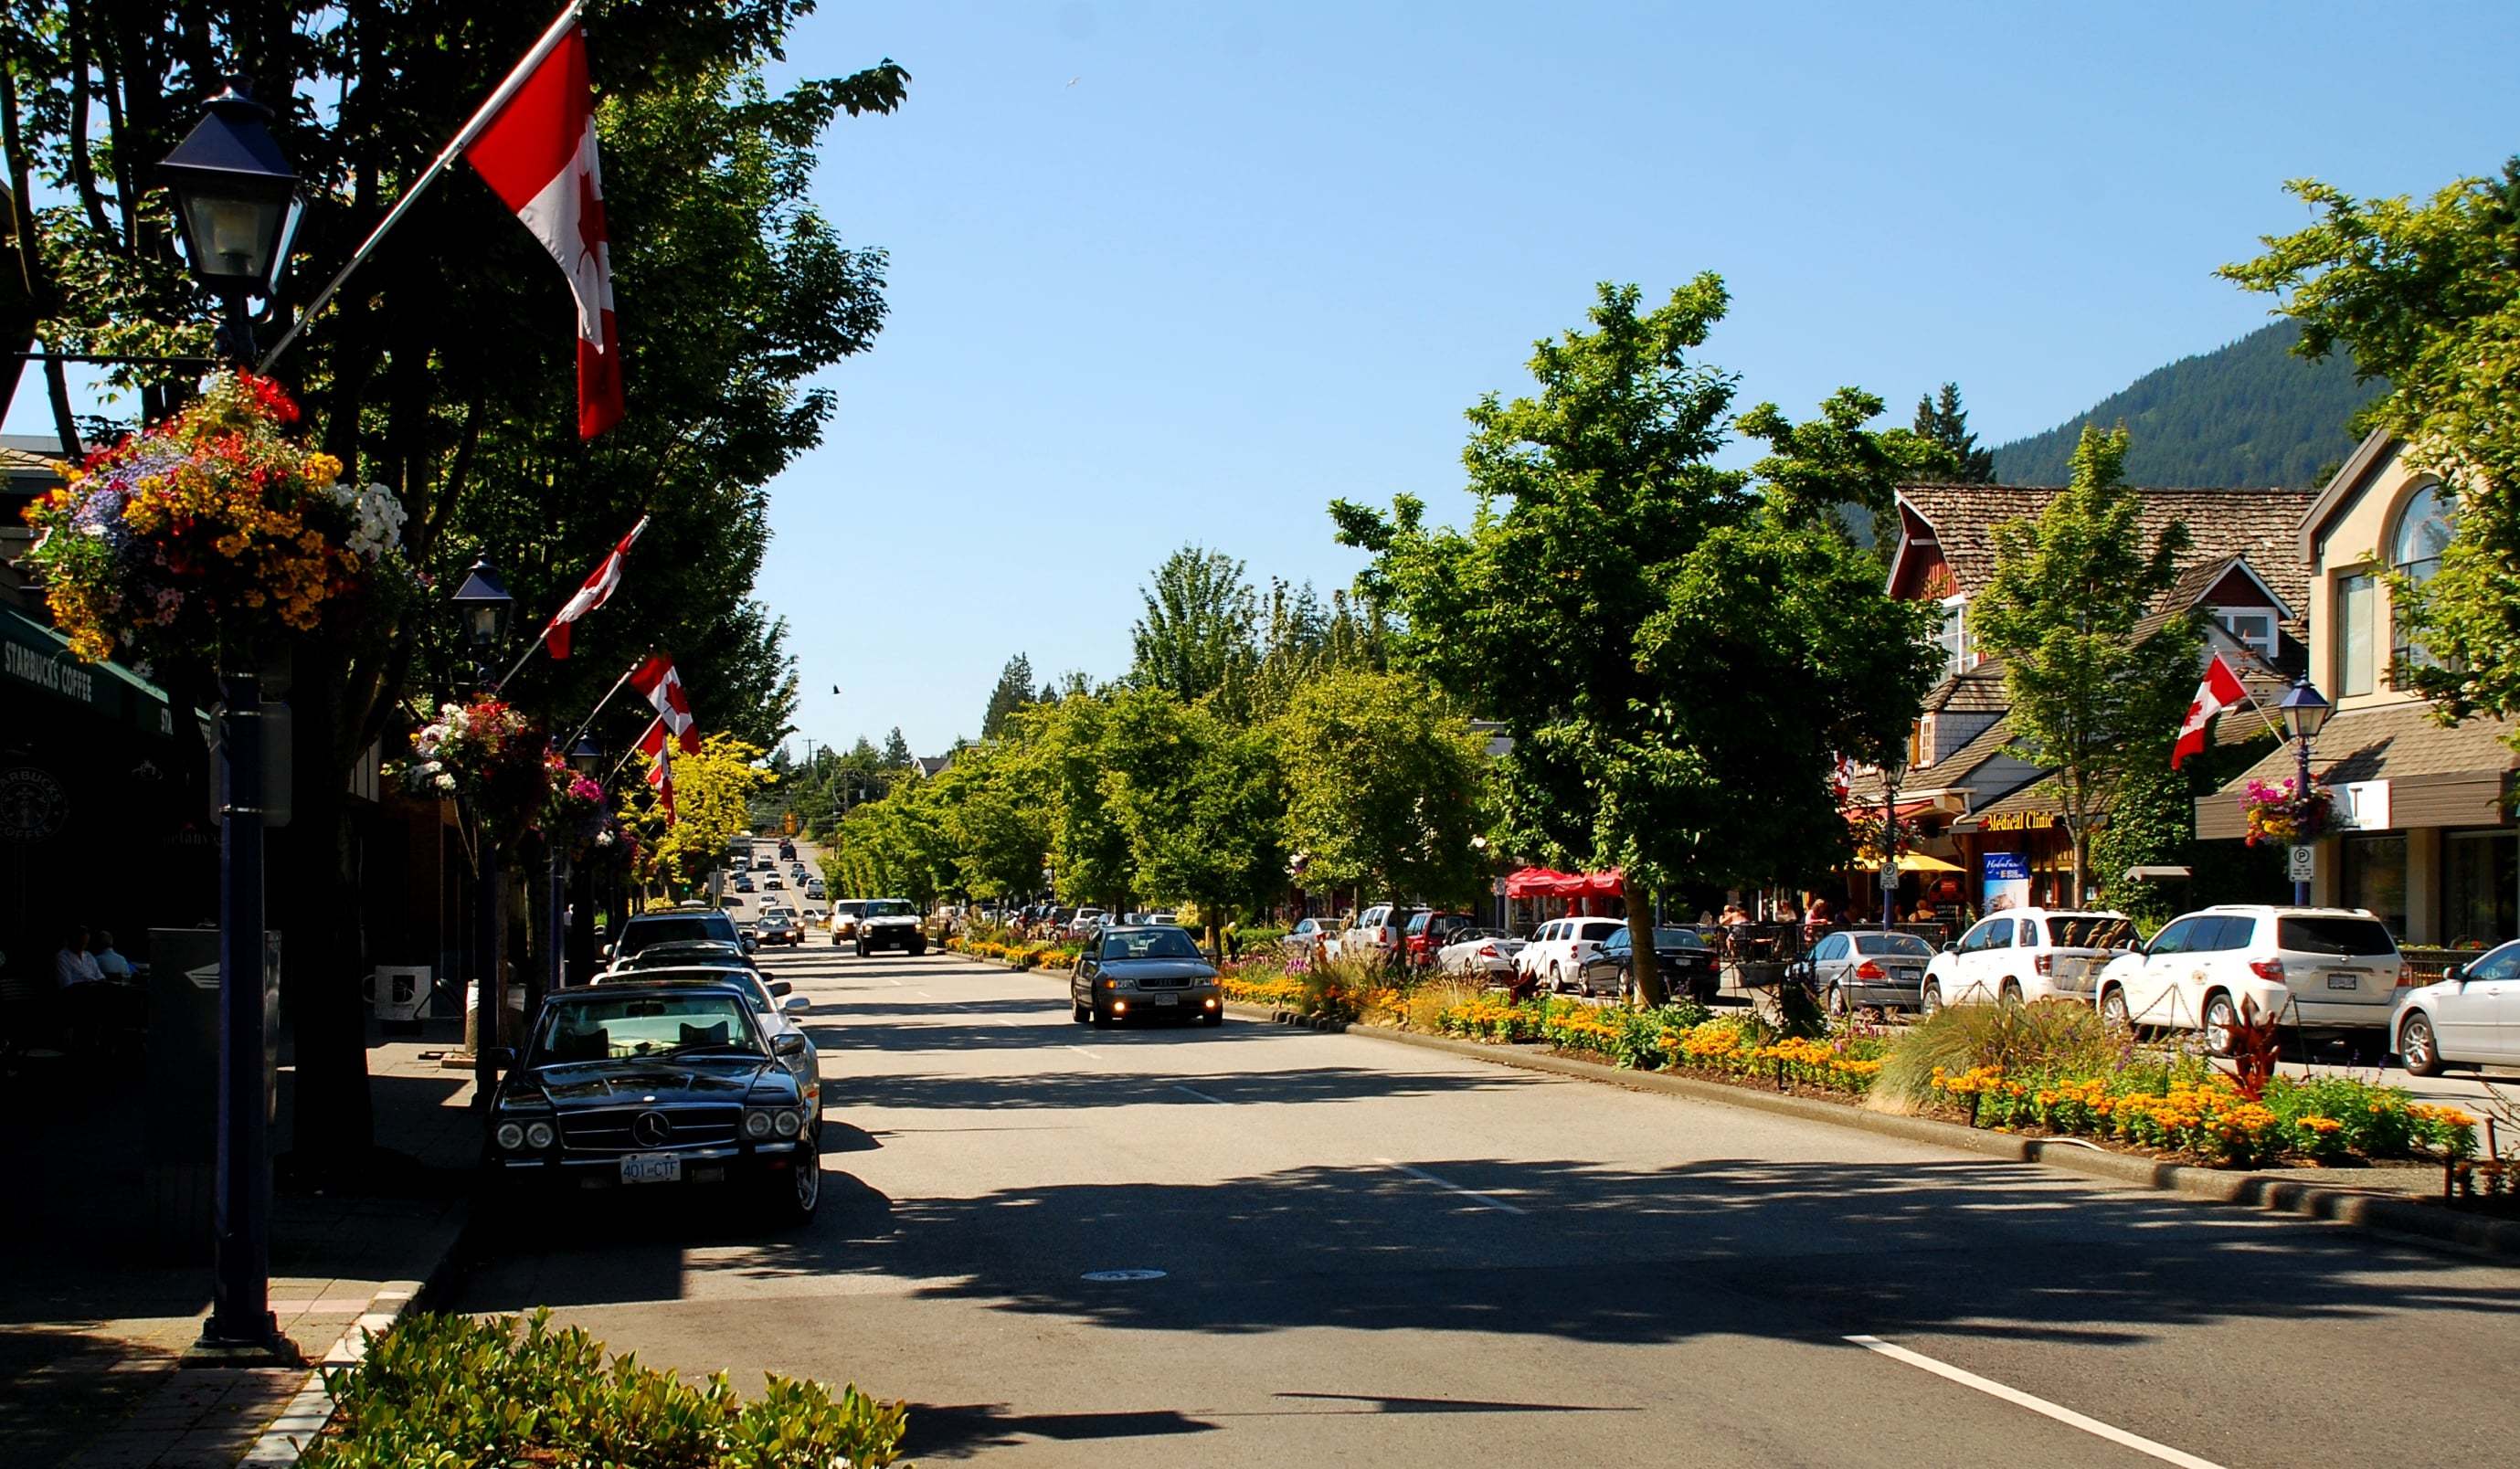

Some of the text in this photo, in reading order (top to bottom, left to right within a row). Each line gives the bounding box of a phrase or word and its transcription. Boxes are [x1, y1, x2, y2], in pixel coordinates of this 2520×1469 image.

[5, 640, 92, 703] STARBUCKS COFFEE
[1987, 810, 2054, 831] Medical Clinic
